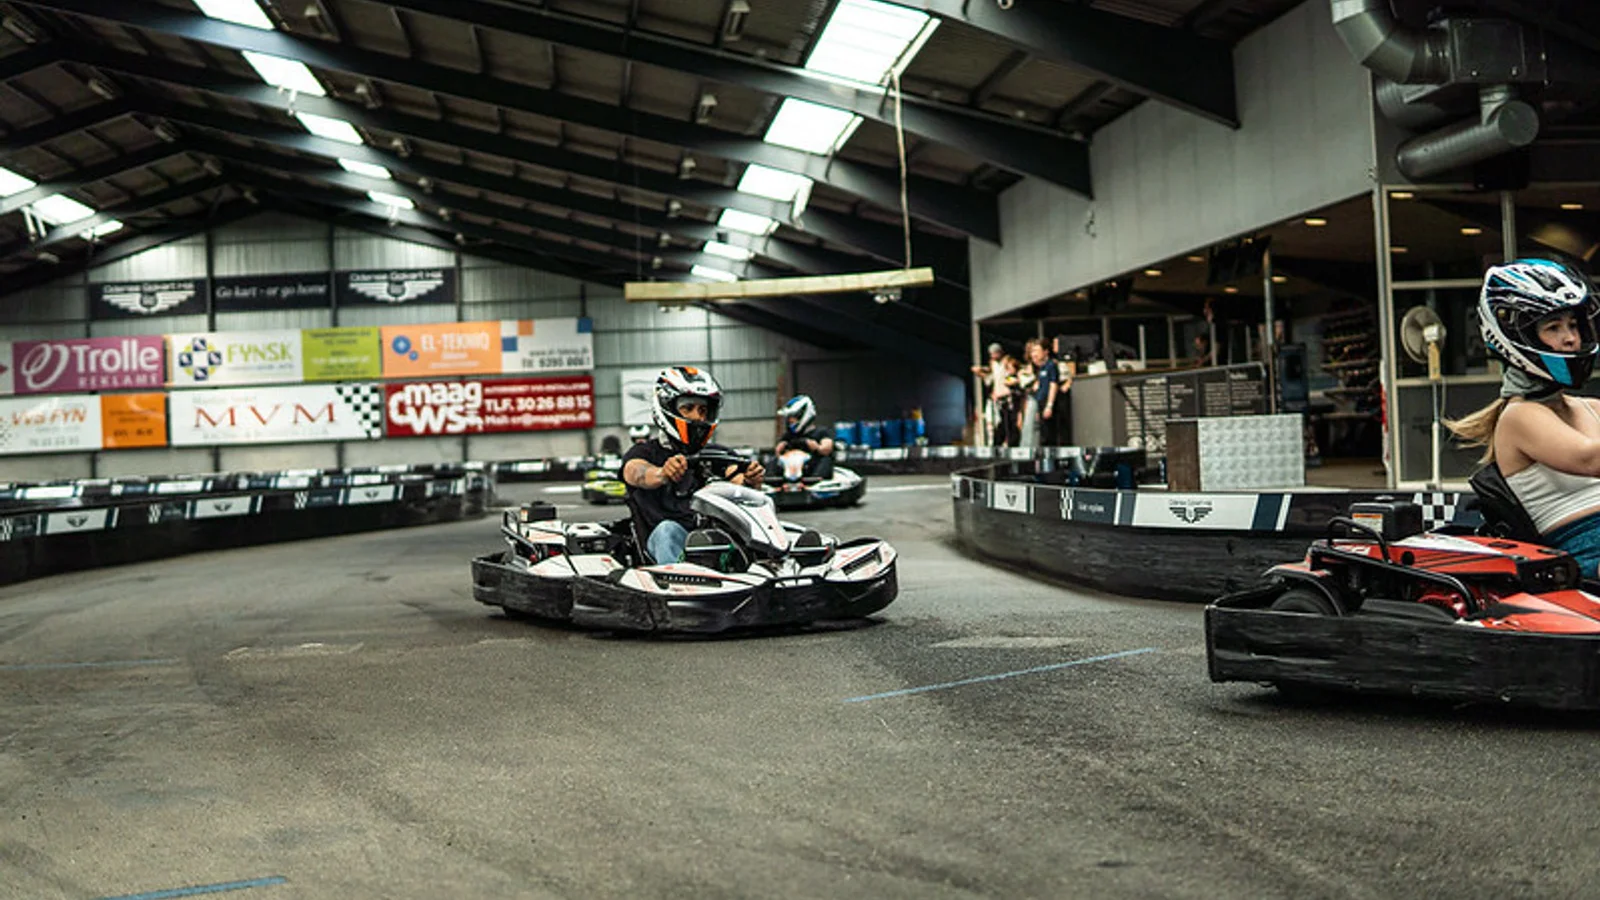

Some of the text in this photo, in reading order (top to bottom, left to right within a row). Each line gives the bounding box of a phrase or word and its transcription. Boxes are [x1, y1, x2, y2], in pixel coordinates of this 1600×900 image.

[216, 286, 231, 298] Go
[235, 285, 256, 298] kart
[71, 339, 160, 373] Trolle
[227, 341, 293, 363] FYNSK
[78, 374, 159, 389] REKLAME
[404, 381, 483, 411] maag
[484, 398, 515, 413] TLF.
[515, 397, 535, 411] 30
[576, 394, 590, 409] 15
[194, 401, 336, 428] MVM
